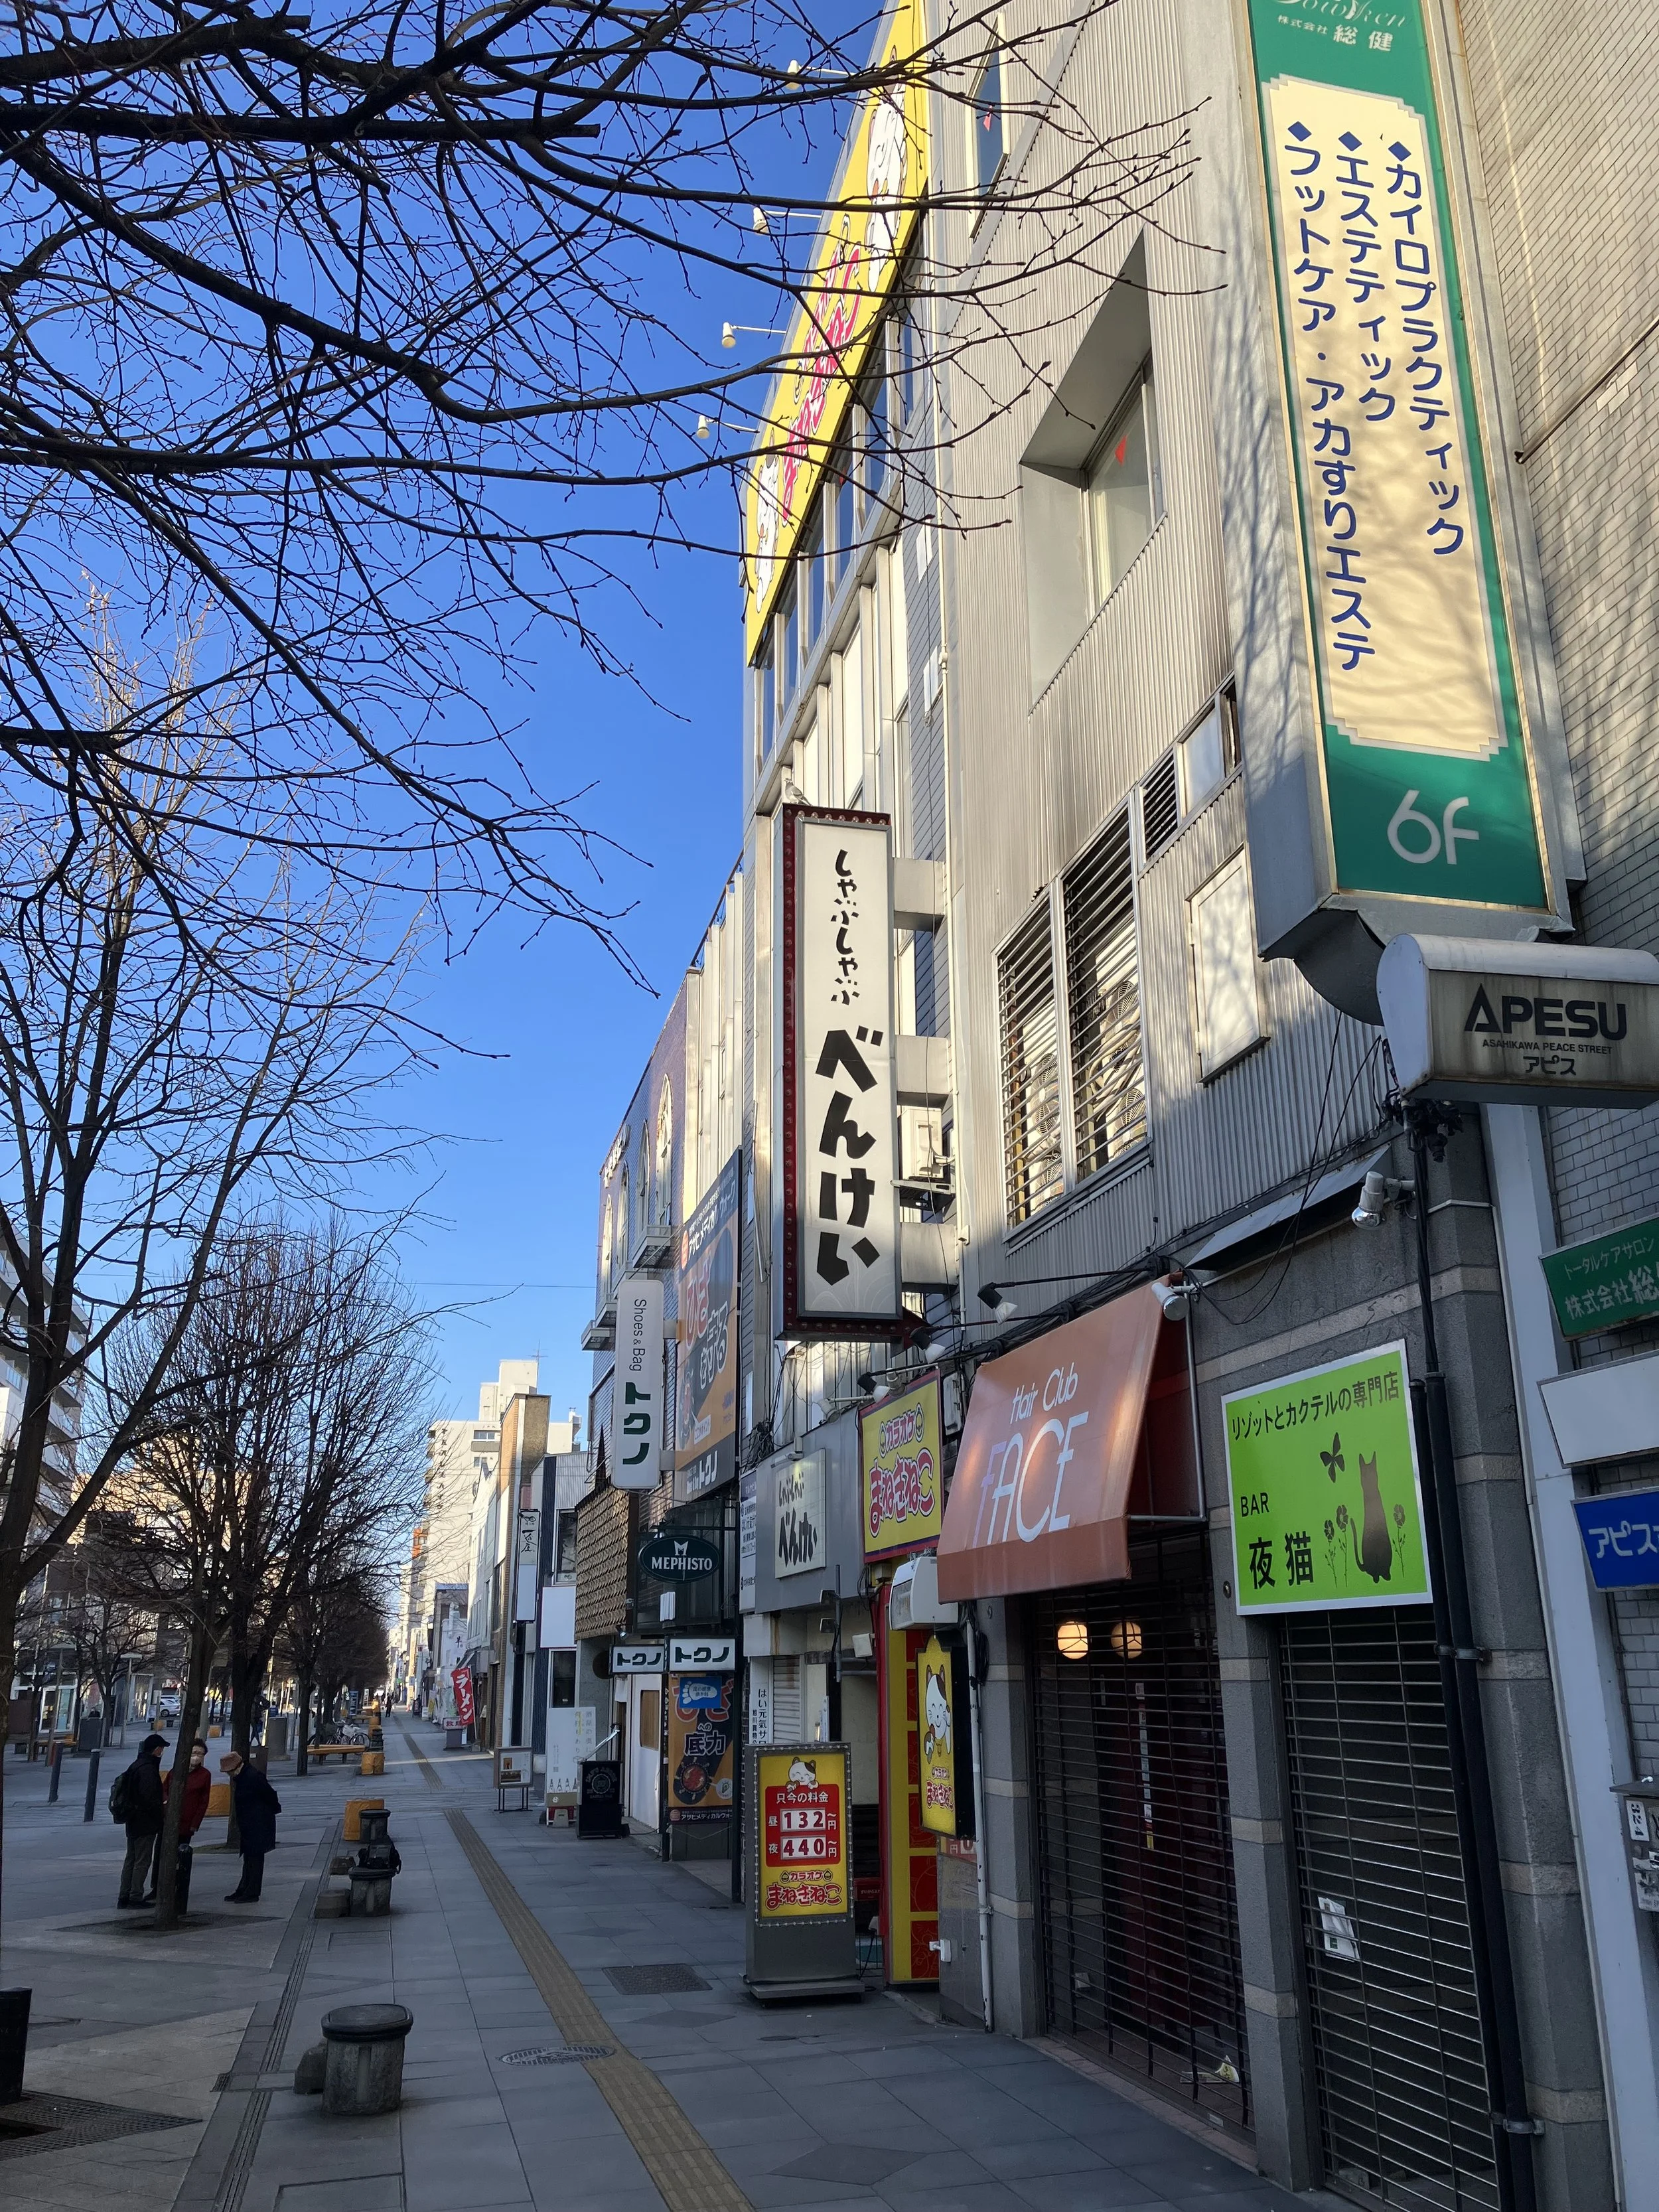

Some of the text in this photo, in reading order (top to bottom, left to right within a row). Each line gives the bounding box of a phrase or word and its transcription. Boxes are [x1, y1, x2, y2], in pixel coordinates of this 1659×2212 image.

[1277, 15, 1393, 52] 株式会社 総健
[1336, 155, 1395, 421] エステティック
[1386, 163, 1464, 555] カイロプラクティック
[1284, 145, 1375, 670] フットケア・アカすりエステ
[1387, 789, 1479, 865] 6F
[831, 849, 860, 1006] しゃぶしゃぶ
[1464, 983, 1627, 1041] APESU
[1482, 1039, 1613, 1055] ASAHIKAWA PEACE STREET
[1523, 1055, 1577, 1076] アピス
[816, 1025, 884, 1286] べんけい
[1564, 1237, 1654, 1280] トータルケアサロン
[1565, 1261, 1659, 1320] 株式会社総
[634, 1298, 647, 1336] Shoes
[629, 1348, 646, 1372] Bag
[1010, 1362, 1078, 1424] Hair Club
[1232, 1371, 1400, 1441] リゾットとカクテルの専門店
[622, 1382, 651, 1465] トクノ
[887, 1411, 914, 1452] カラオケ
[870, 1447, 935, 1538] まねきねこ
[973, 1412, 1089, 1548] FACE
[1240, 1492, 1269, 1517] BAR
[778, 1507, 818, 1568] べんけい
[1588, 1520, 1659, 1559] アピス
[652, 1556, 713, 1571] MEPHISTO
[1249, 1530, 1314, 1589] 夜猫
[616, 1653, 662, 1666] トクノ
[675, 1647, 729, 1663] トクノ
[455, 1673, 472, 1721] ラーメン
[684, 1730, 726, 1756] 底力
[776, 1791, 829, 1805] 只今の料金
[768, 1815, 778, 1826] 昼
[784, 1810, 824, 1829] 132
[768, 1843, 778, 1854] 夜
[783, 1838, 824, 1856] 440
[765, 1882, 843, 1911] まねきねこ
[790, 1870, 824, 1882] カラオケ
